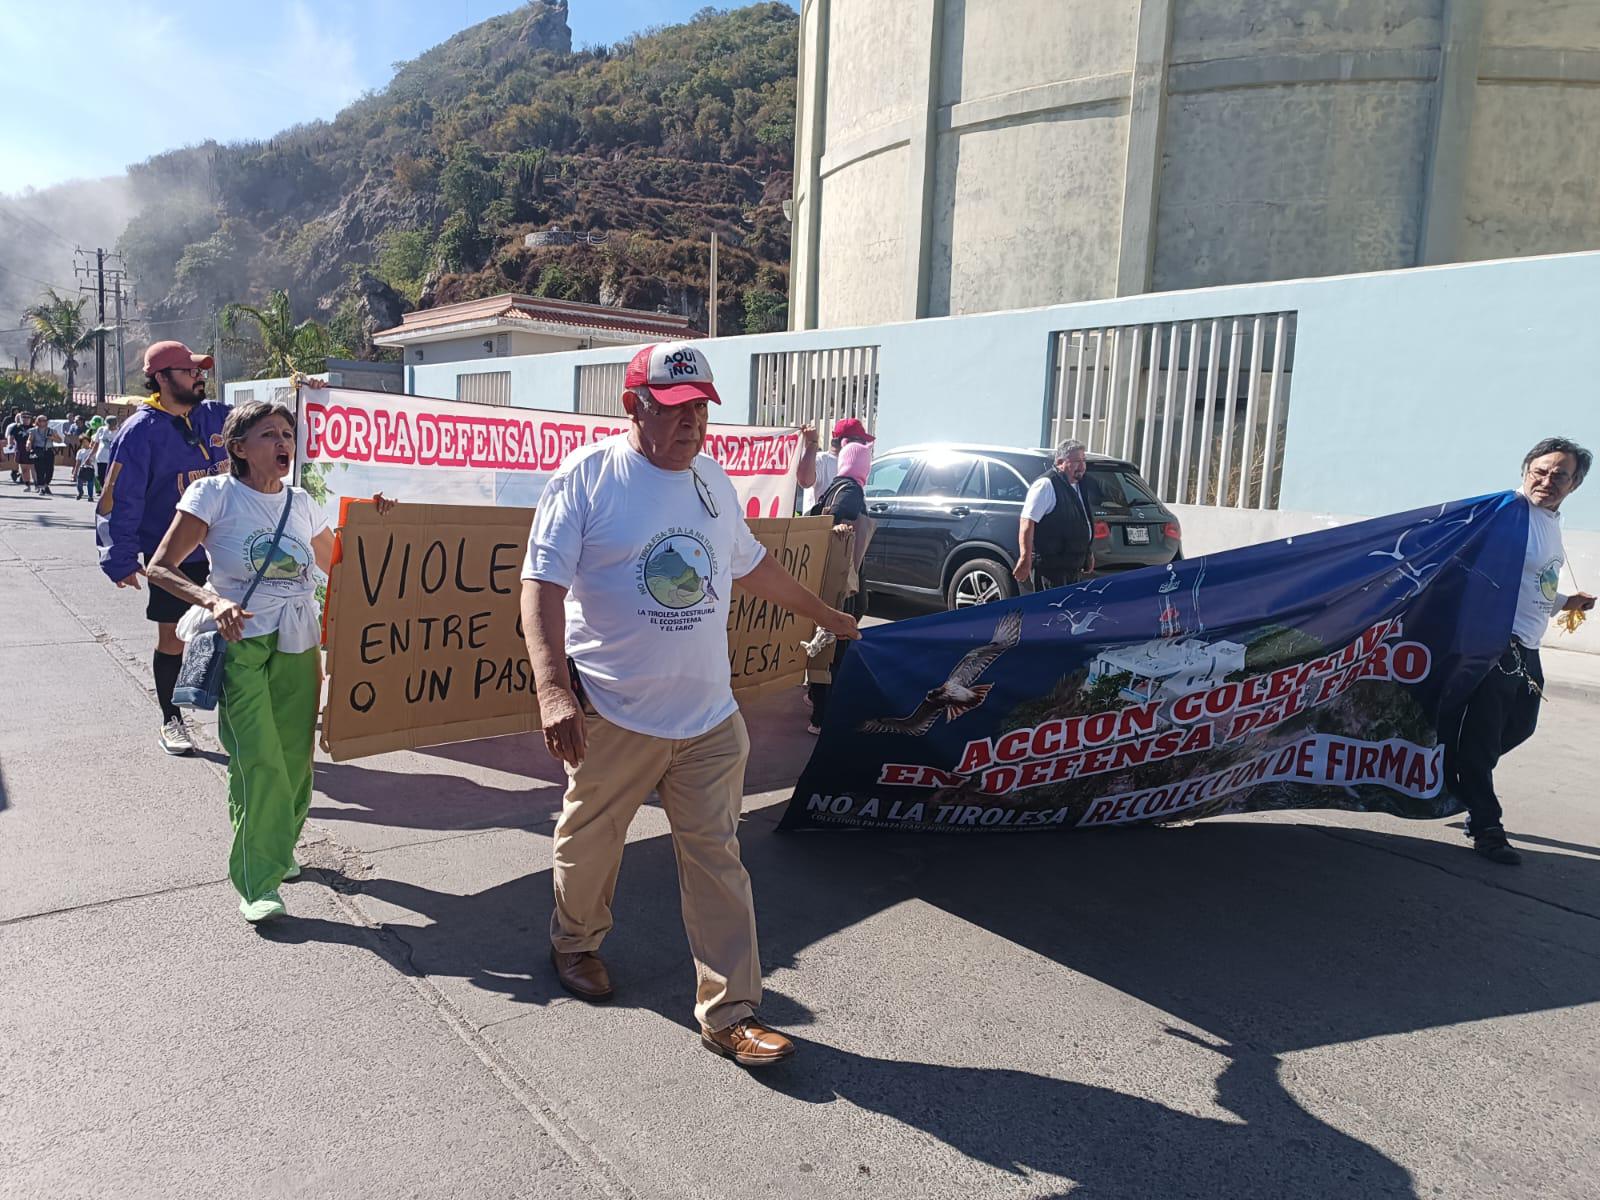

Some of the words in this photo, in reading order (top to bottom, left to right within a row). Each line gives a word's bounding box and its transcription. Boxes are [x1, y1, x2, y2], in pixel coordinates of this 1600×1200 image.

[664, 351, 696, 364] AQUI
[306, 403, 371, 461] POR
[374, 410, 415, 465] LA
[416, 413, 538, 470] DEFENSA
[677, 526, 683, 534] A
[685, 528, 694, 536] LA
[358, 533, 519, 606] VIOLE
[635, 563, 643, 574] LA
[637, 583, 647, 595] NO
[637, 608, 646, 616] LA
[648, 610, 679, 618] TIROLESA
[660, 617, 701, 625] ECOSISTEMA
[360, 611, 492, 665] ENTRE
[350, 680, 376, 713] O
[405, 666, 452, 703] UN
[877, 763, 970, 789] EN
[979, 722, 1215, 795] DEFENSA
[1223, 686, 1308, 745] DEL
[1311, 641, 1432, 707] FARO
[956, 700, 1164, 775] ACCION
[1089, 753, 1276, 823] RECOLECCION
[1273, 740, 1316, 778] DE
[1325, 742, 1442, 793] FIRMAS
[806, 793, 853, 814] NO
[856, 798, 880, 818] A
[887, 800, 925, 822] LA
[935, 805, 1069, 826] TIROLESA
